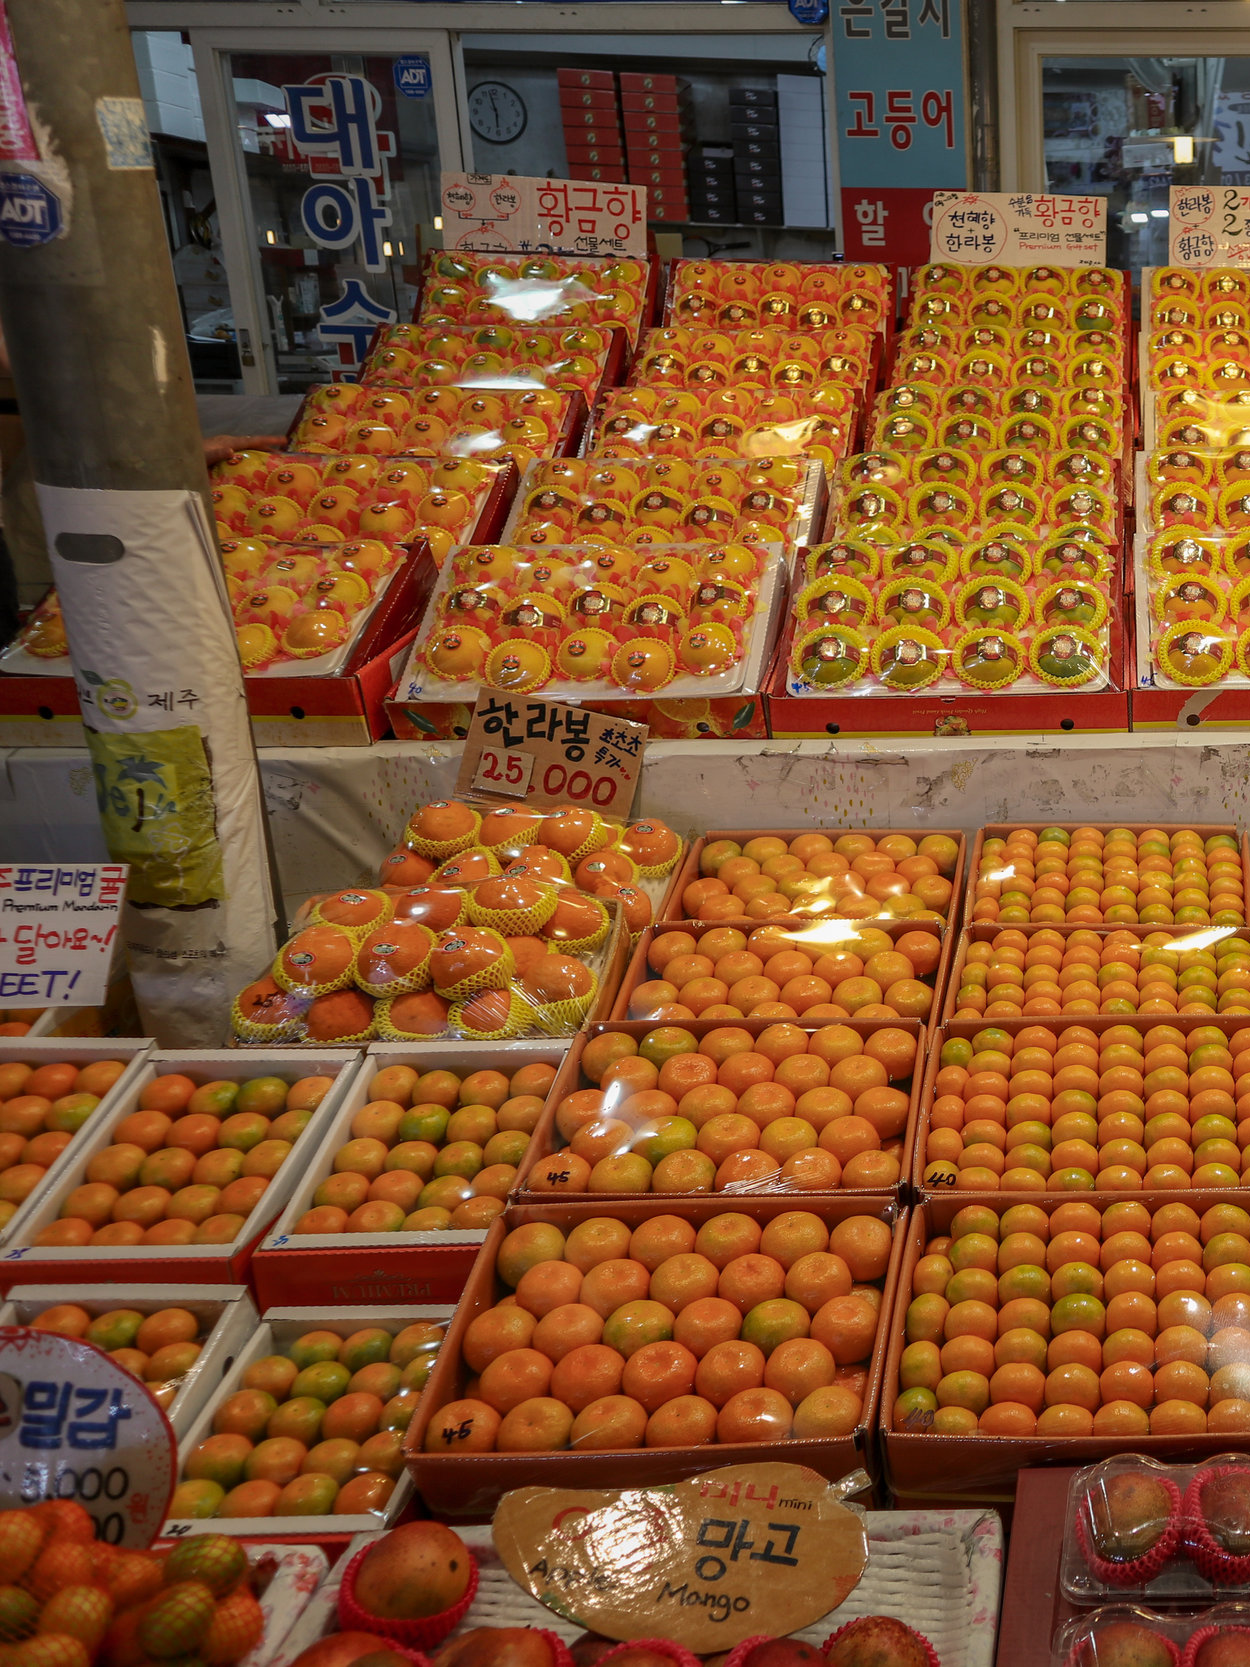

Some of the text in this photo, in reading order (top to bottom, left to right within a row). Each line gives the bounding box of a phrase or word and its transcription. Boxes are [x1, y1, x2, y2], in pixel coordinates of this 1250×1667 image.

[400, 69, 426, 84] ADT
[845, 89, 956, 151] 고등어
[1, 198, 48, 225] ADT
[536, 181, 642, 240] 황금향
[1034, 195, 1101, 229] 황금향
[1177, 193, 1214, 217] 한라봉
[281, 76, 397, 383] 대아수
[948, 211, 996, 230] 천혜향
[574, 236, 627, 252] 선물세트
[946, 233, 996, 254] 한라봉
[1019, 242, 1062, 251] Premium
[1178, 234, 1214, 261] 황금향
[147, 688, 200, 712] 제주
[477, 697, 590, 763] 한라봉
[594, 746, 622, 768] 특가
[14, 866, 127, 903] 프리미엄 귤
[2, 899, 119, 912] Premium Mandarin
[546, 1171, 571, 1185] 45
[927, 1172, 957, 1186] 40
[19, 1381, 131, 1450] 밀감
[778, 1497, 813, 1511] mini
[695, 1517, 801, 1581] 망고
[656, 1580, 750, 1623] Mango
